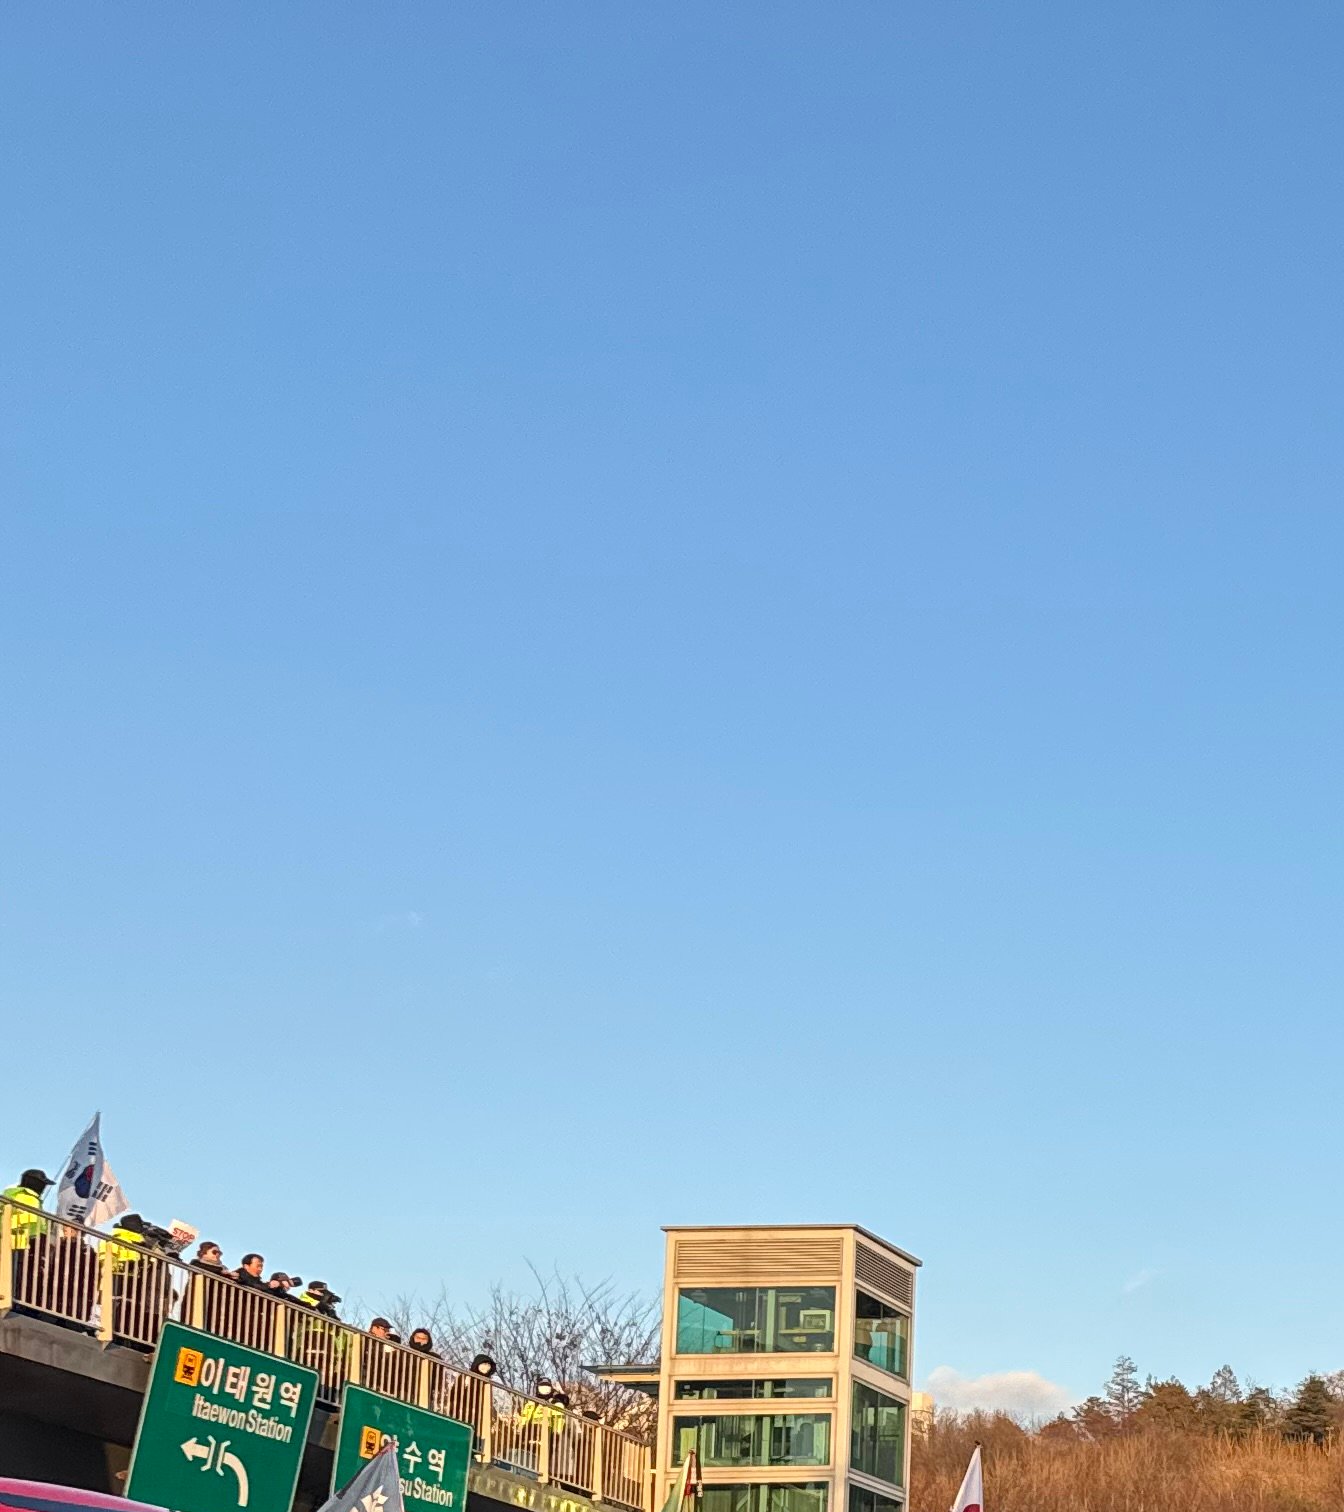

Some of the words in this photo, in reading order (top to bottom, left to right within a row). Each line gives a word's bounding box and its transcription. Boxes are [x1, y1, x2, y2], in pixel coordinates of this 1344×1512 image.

[201, 1357, 302, 1418] 이태원역
[192, 1392, 246, 1430] Itaewon
[246, 1409, 293, 1444] Station
[413, 1476, 453, 1508] Station
